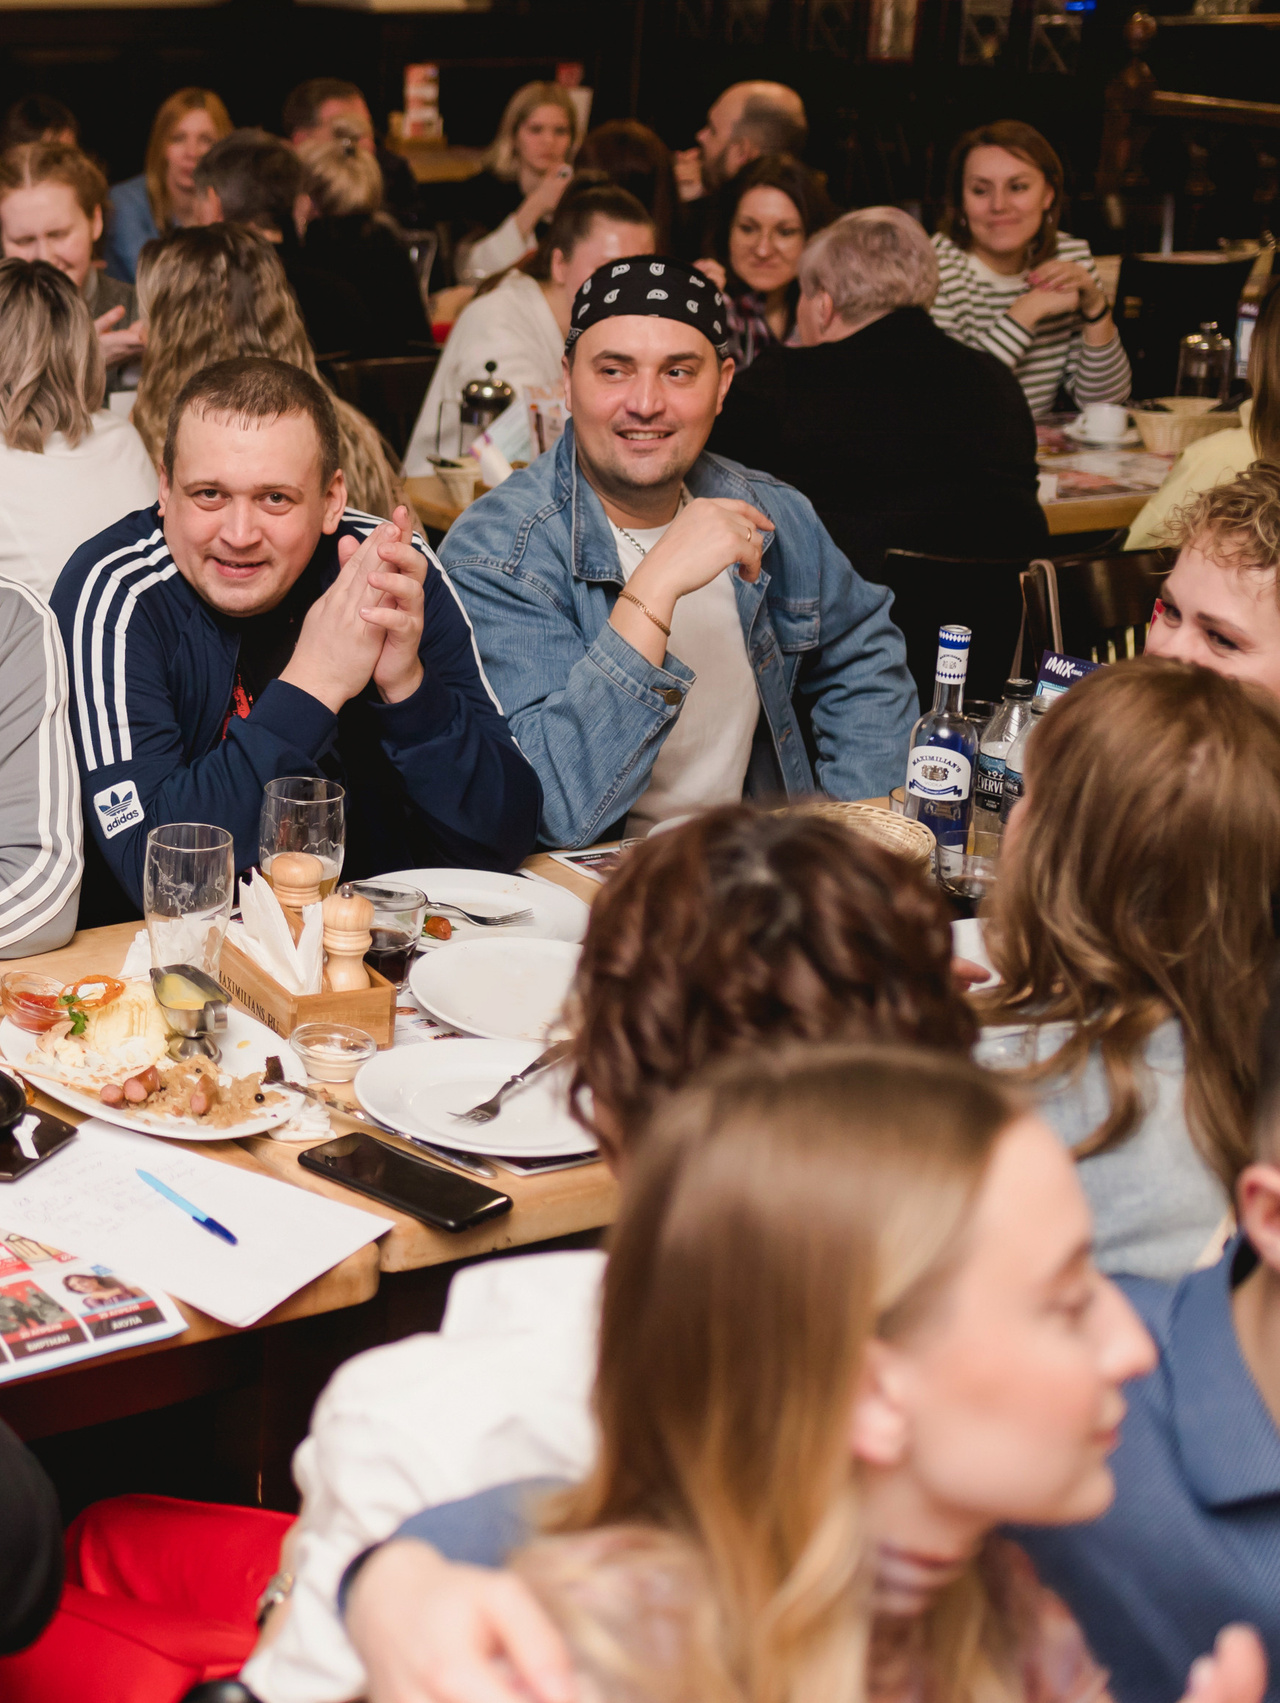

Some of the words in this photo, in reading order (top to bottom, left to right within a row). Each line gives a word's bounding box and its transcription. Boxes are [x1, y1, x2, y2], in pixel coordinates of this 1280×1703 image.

[912, 755, 962, 773] MAXIMILIAN'S
[977, 774, 1004, 795] EVERVE
[107, 810, 140, 832] adidas
[111, 1314, 143, 1331] АКУЛА
